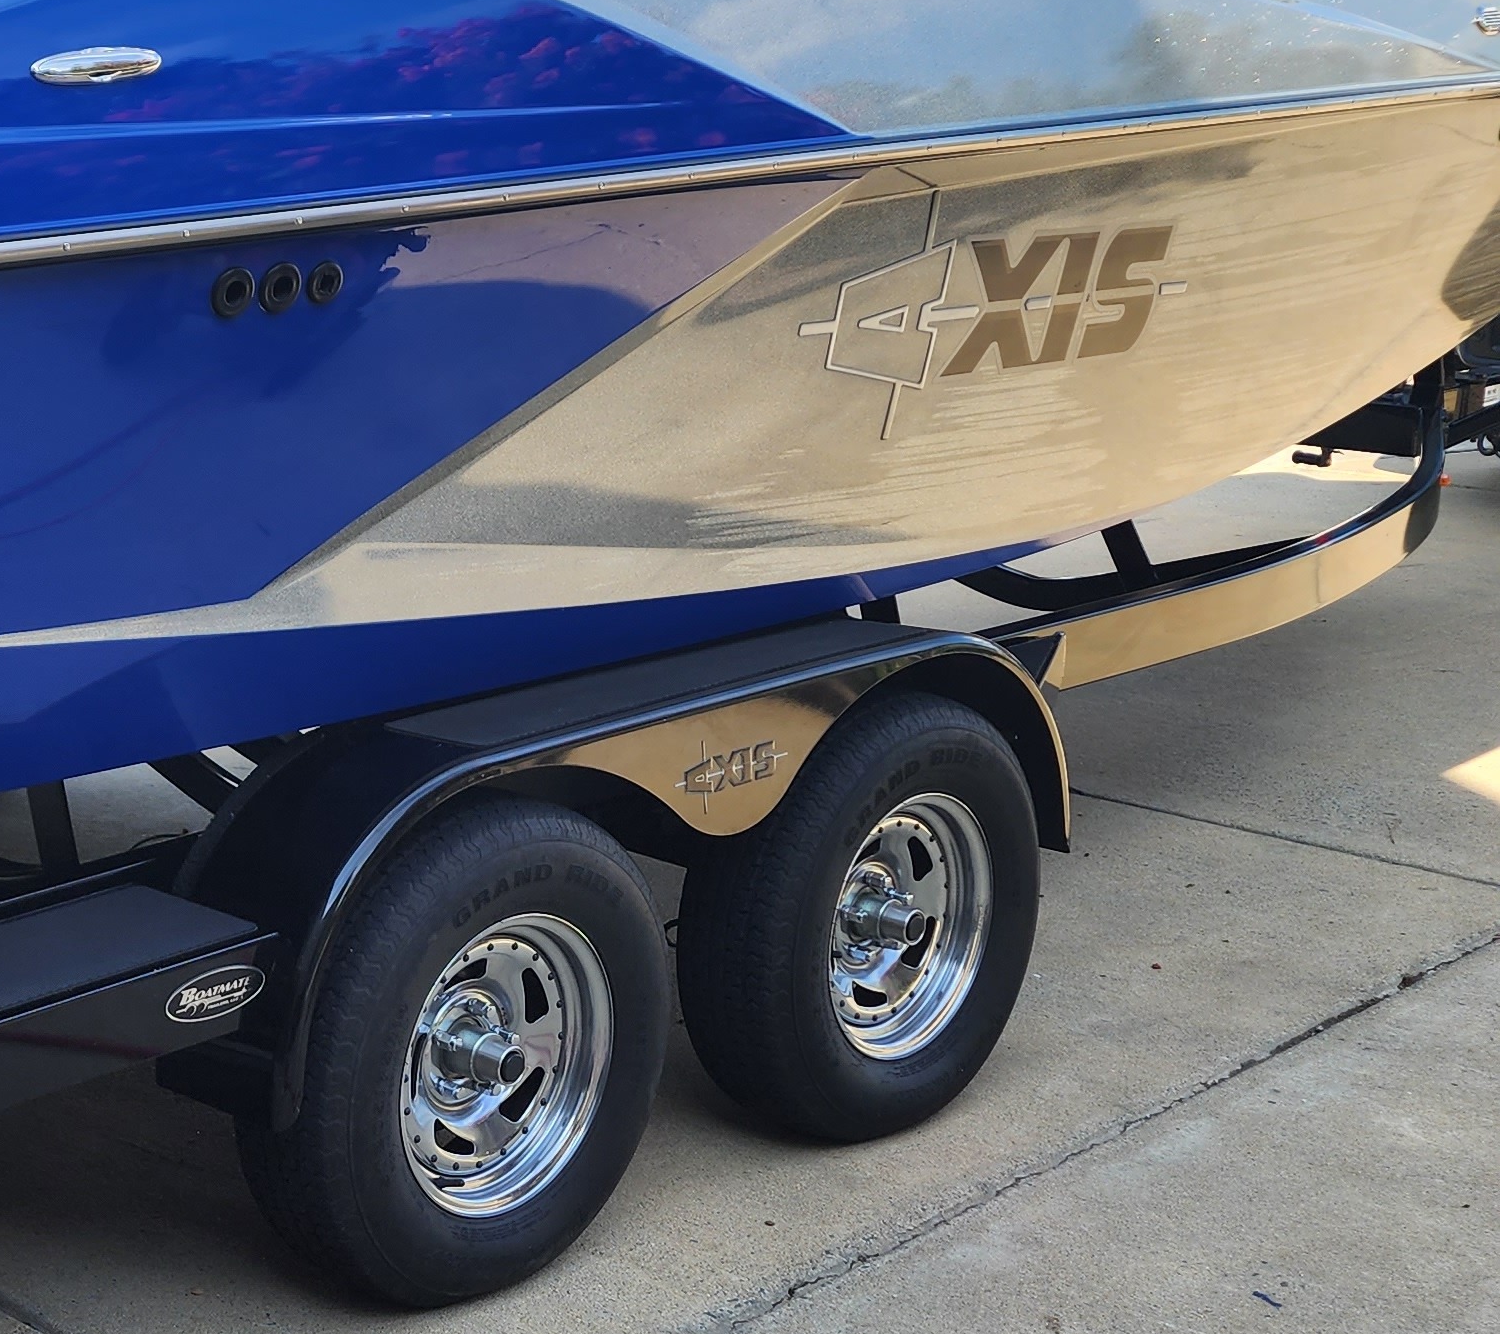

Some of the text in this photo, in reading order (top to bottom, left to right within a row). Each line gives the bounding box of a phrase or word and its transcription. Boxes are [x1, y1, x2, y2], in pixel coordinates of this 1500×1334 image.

[825, 223, 1176, 389] AXIS
[684, 739, 778, 794] AXIS
[451, 863, 626, 930] GRAND RIDE
